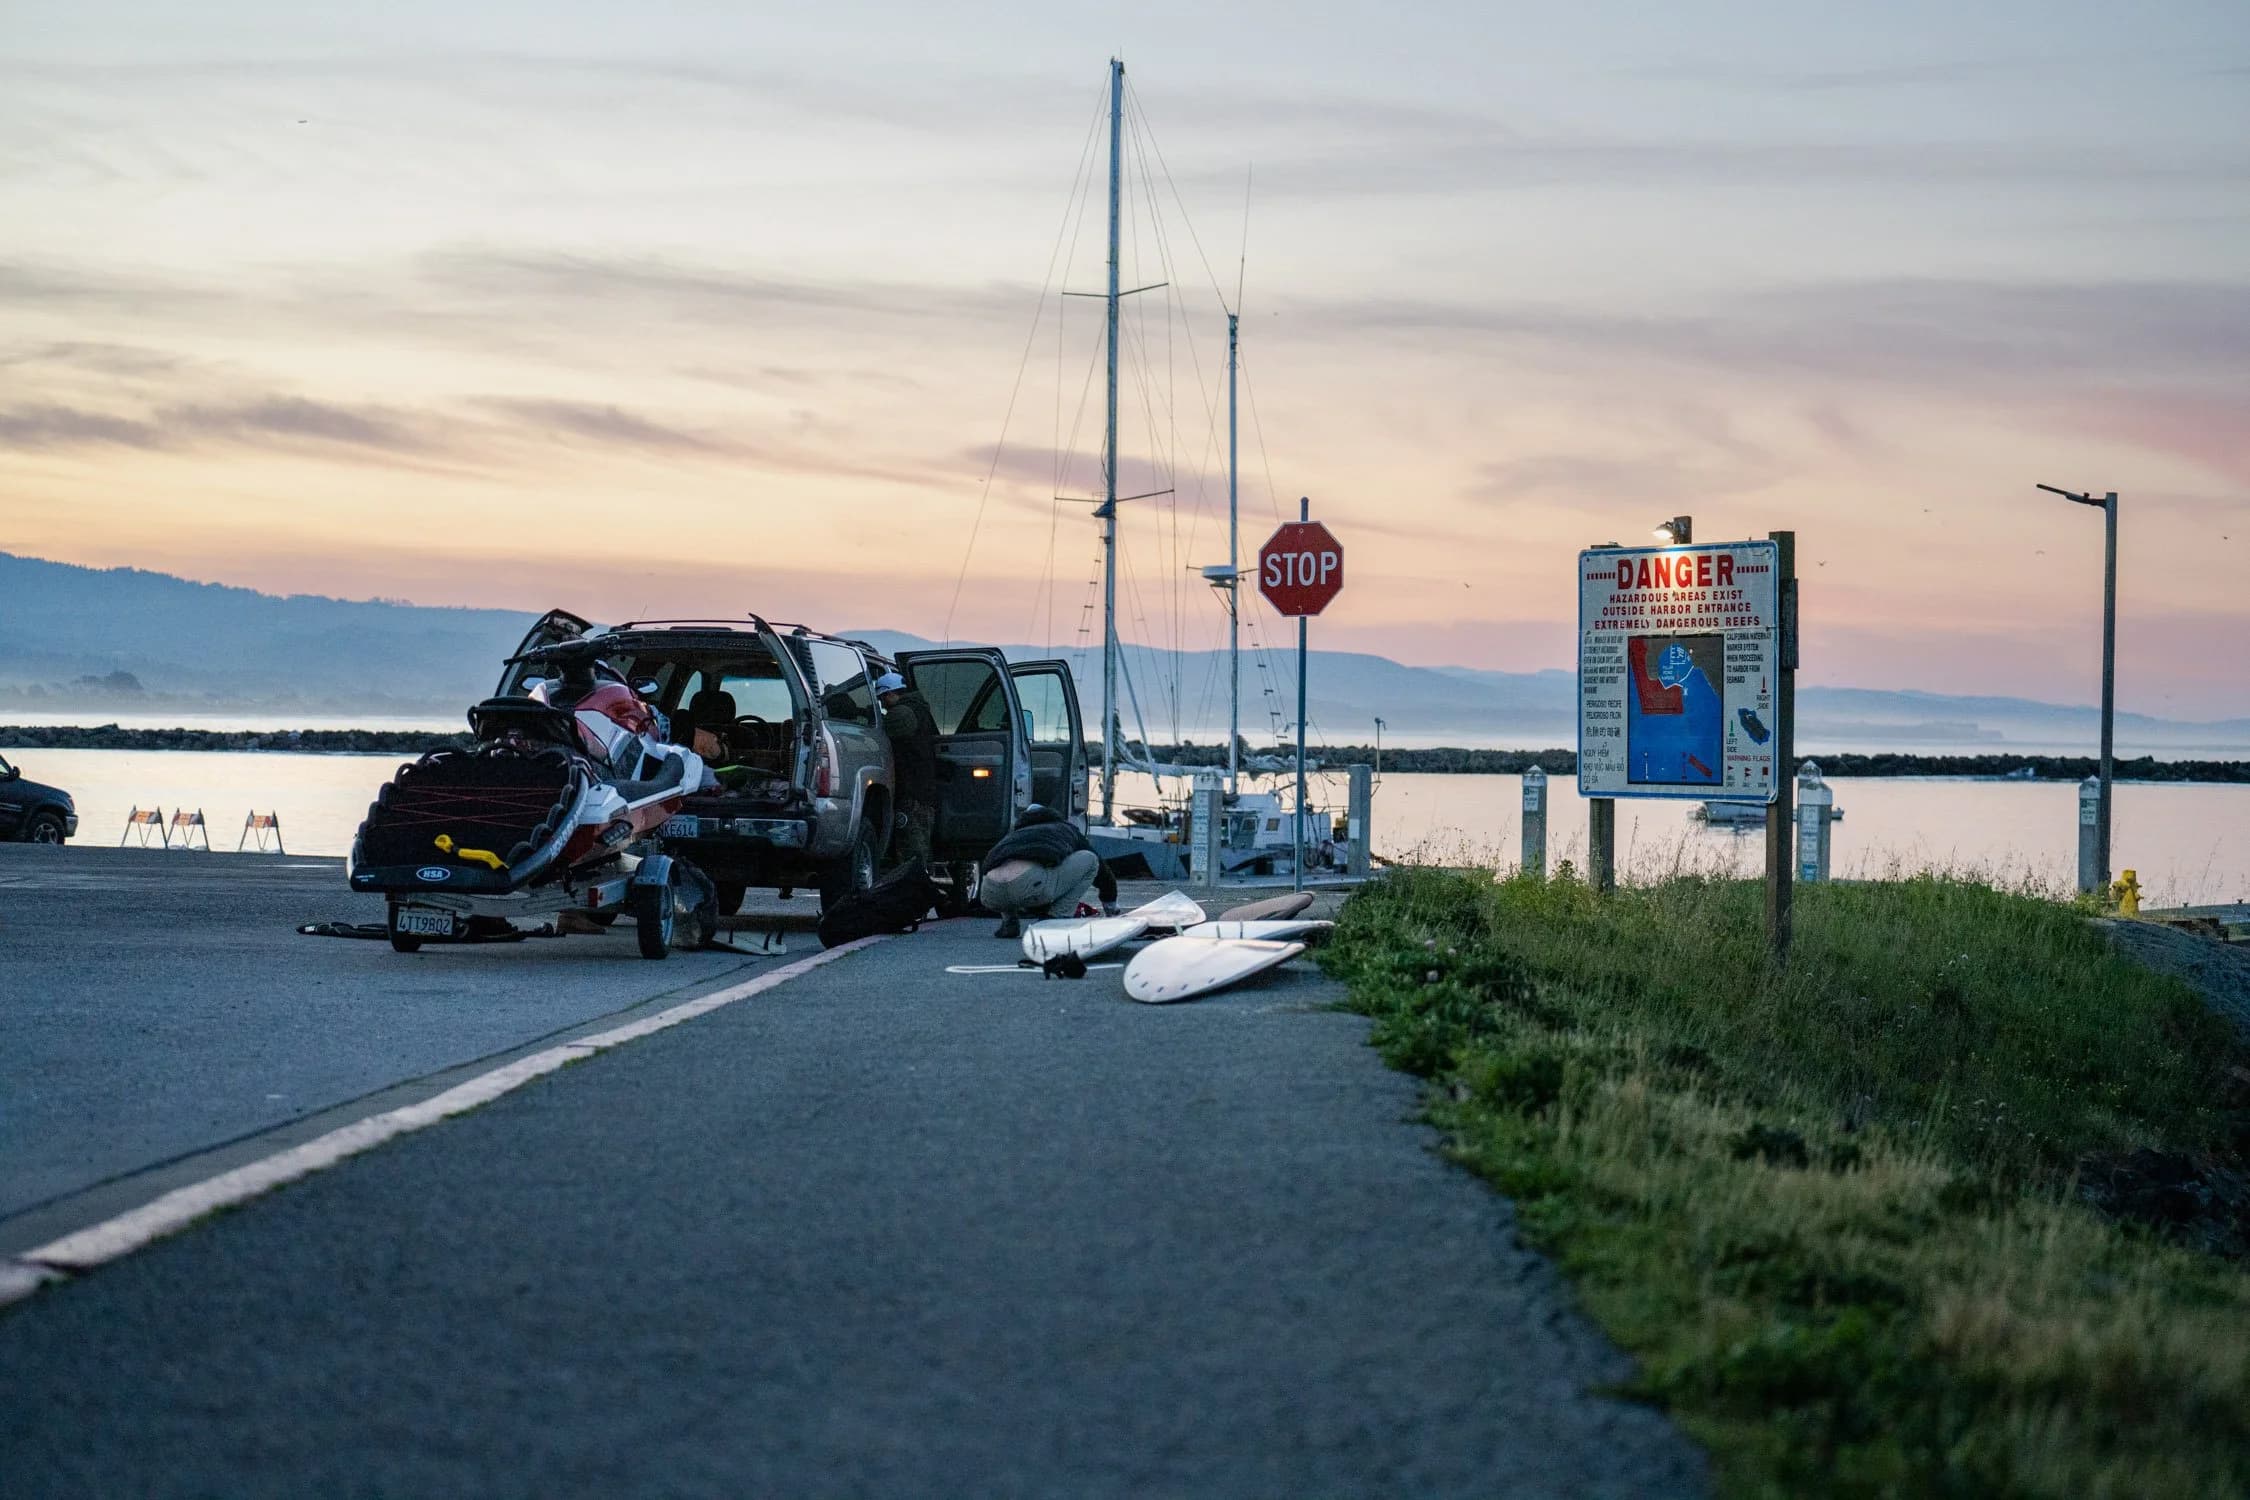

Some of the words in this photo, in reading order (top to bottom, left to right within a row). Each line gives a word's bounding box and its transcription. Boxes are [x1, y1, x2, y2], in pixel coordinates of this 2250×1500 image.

[1265, 551, 1338, 587] STOP
[1617, 554, 1734, 590] DANGER
[1609, 592, 1668, 604] HAZARDOUS
[1674, 591, 1707, 602] AREAS
[1713, 589, 1743, 601] EXIST
[1602, 605, 1645, 617] OUTSIDE
[1650, 603, 1691, 615] HARBOR
[1697, 602, 1751, 613] ENTRANCE
[1594, 618, 1651, 630] EXTREMELY
[1656, 616, 1719, 628] DANGEROUS
[1725, 615, 1760, 627] REEFS
